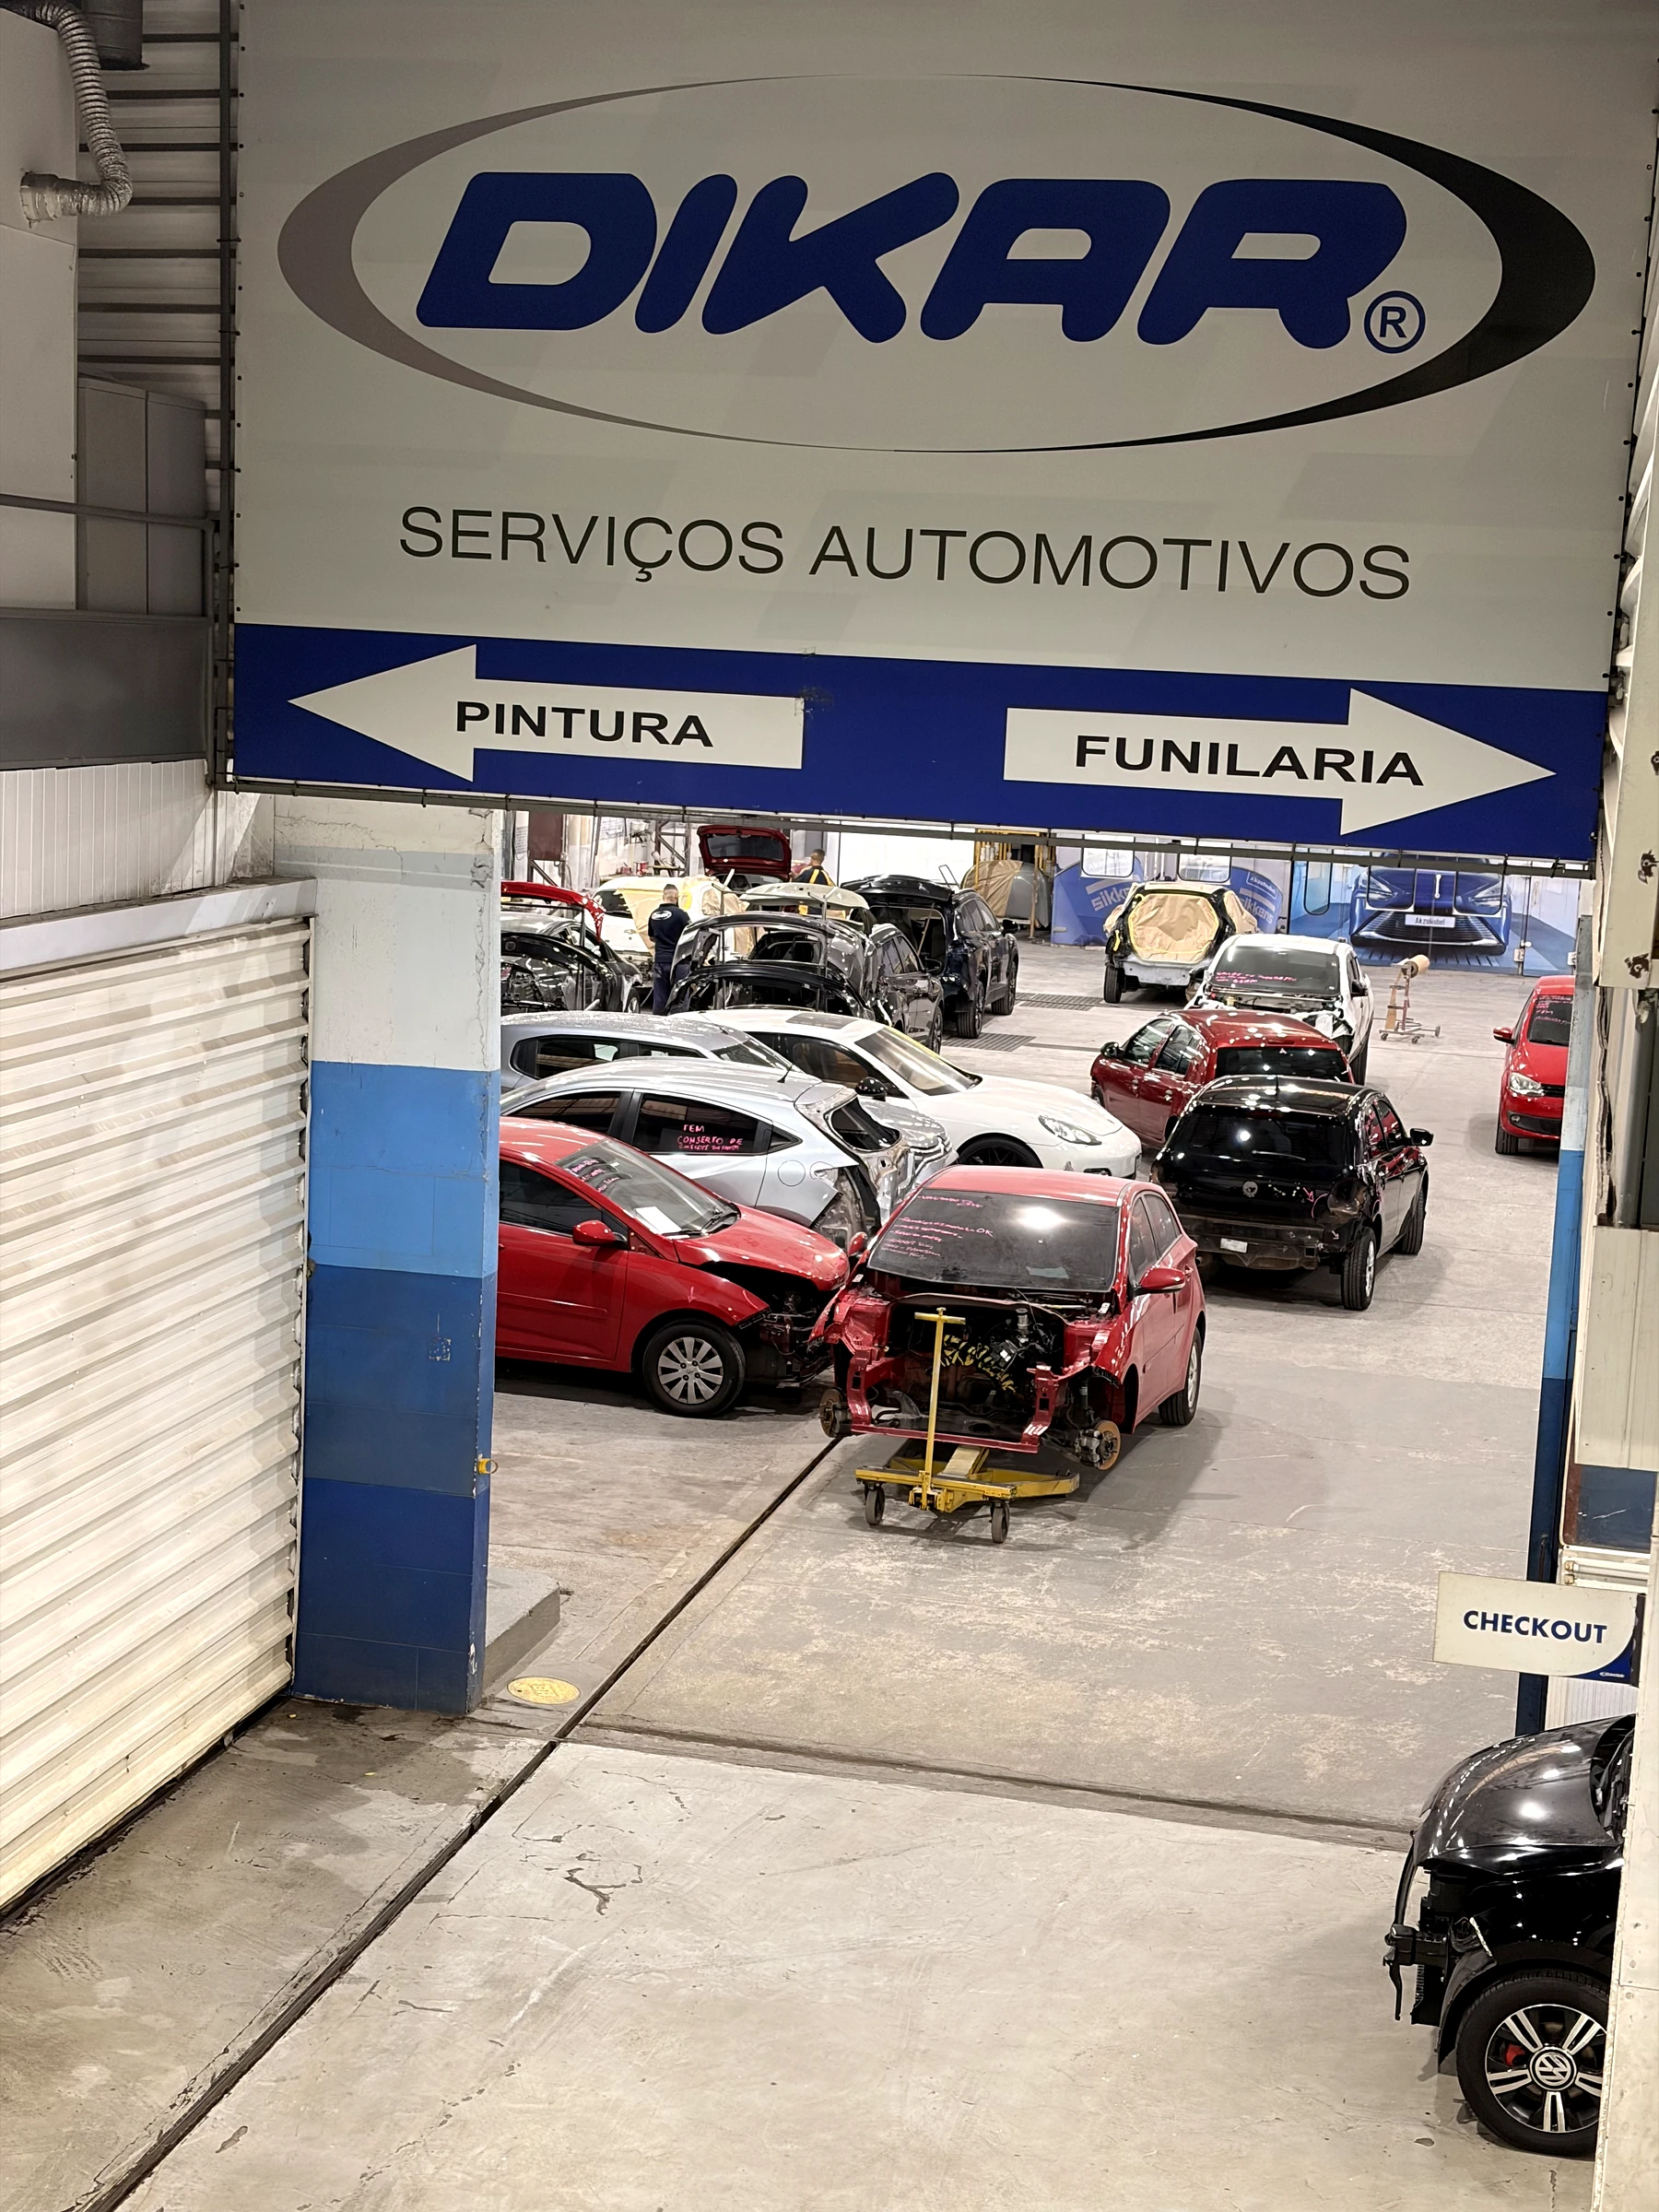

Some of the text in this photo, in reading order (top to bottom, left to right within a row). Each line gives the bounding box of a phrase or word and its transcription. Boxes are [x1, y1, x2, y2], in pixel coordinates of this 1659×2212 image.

[417, 172, 1408, 349] DIKAR
[399, 506, 1410, 600] SERVIÇOS AUTOMOTIVOS
[456, 700, 713, 747] PINTURA
[1076, 735, 1424, 786] FUNILARIA
[1463, 1610, 1607, 1644] CHECKOUT
